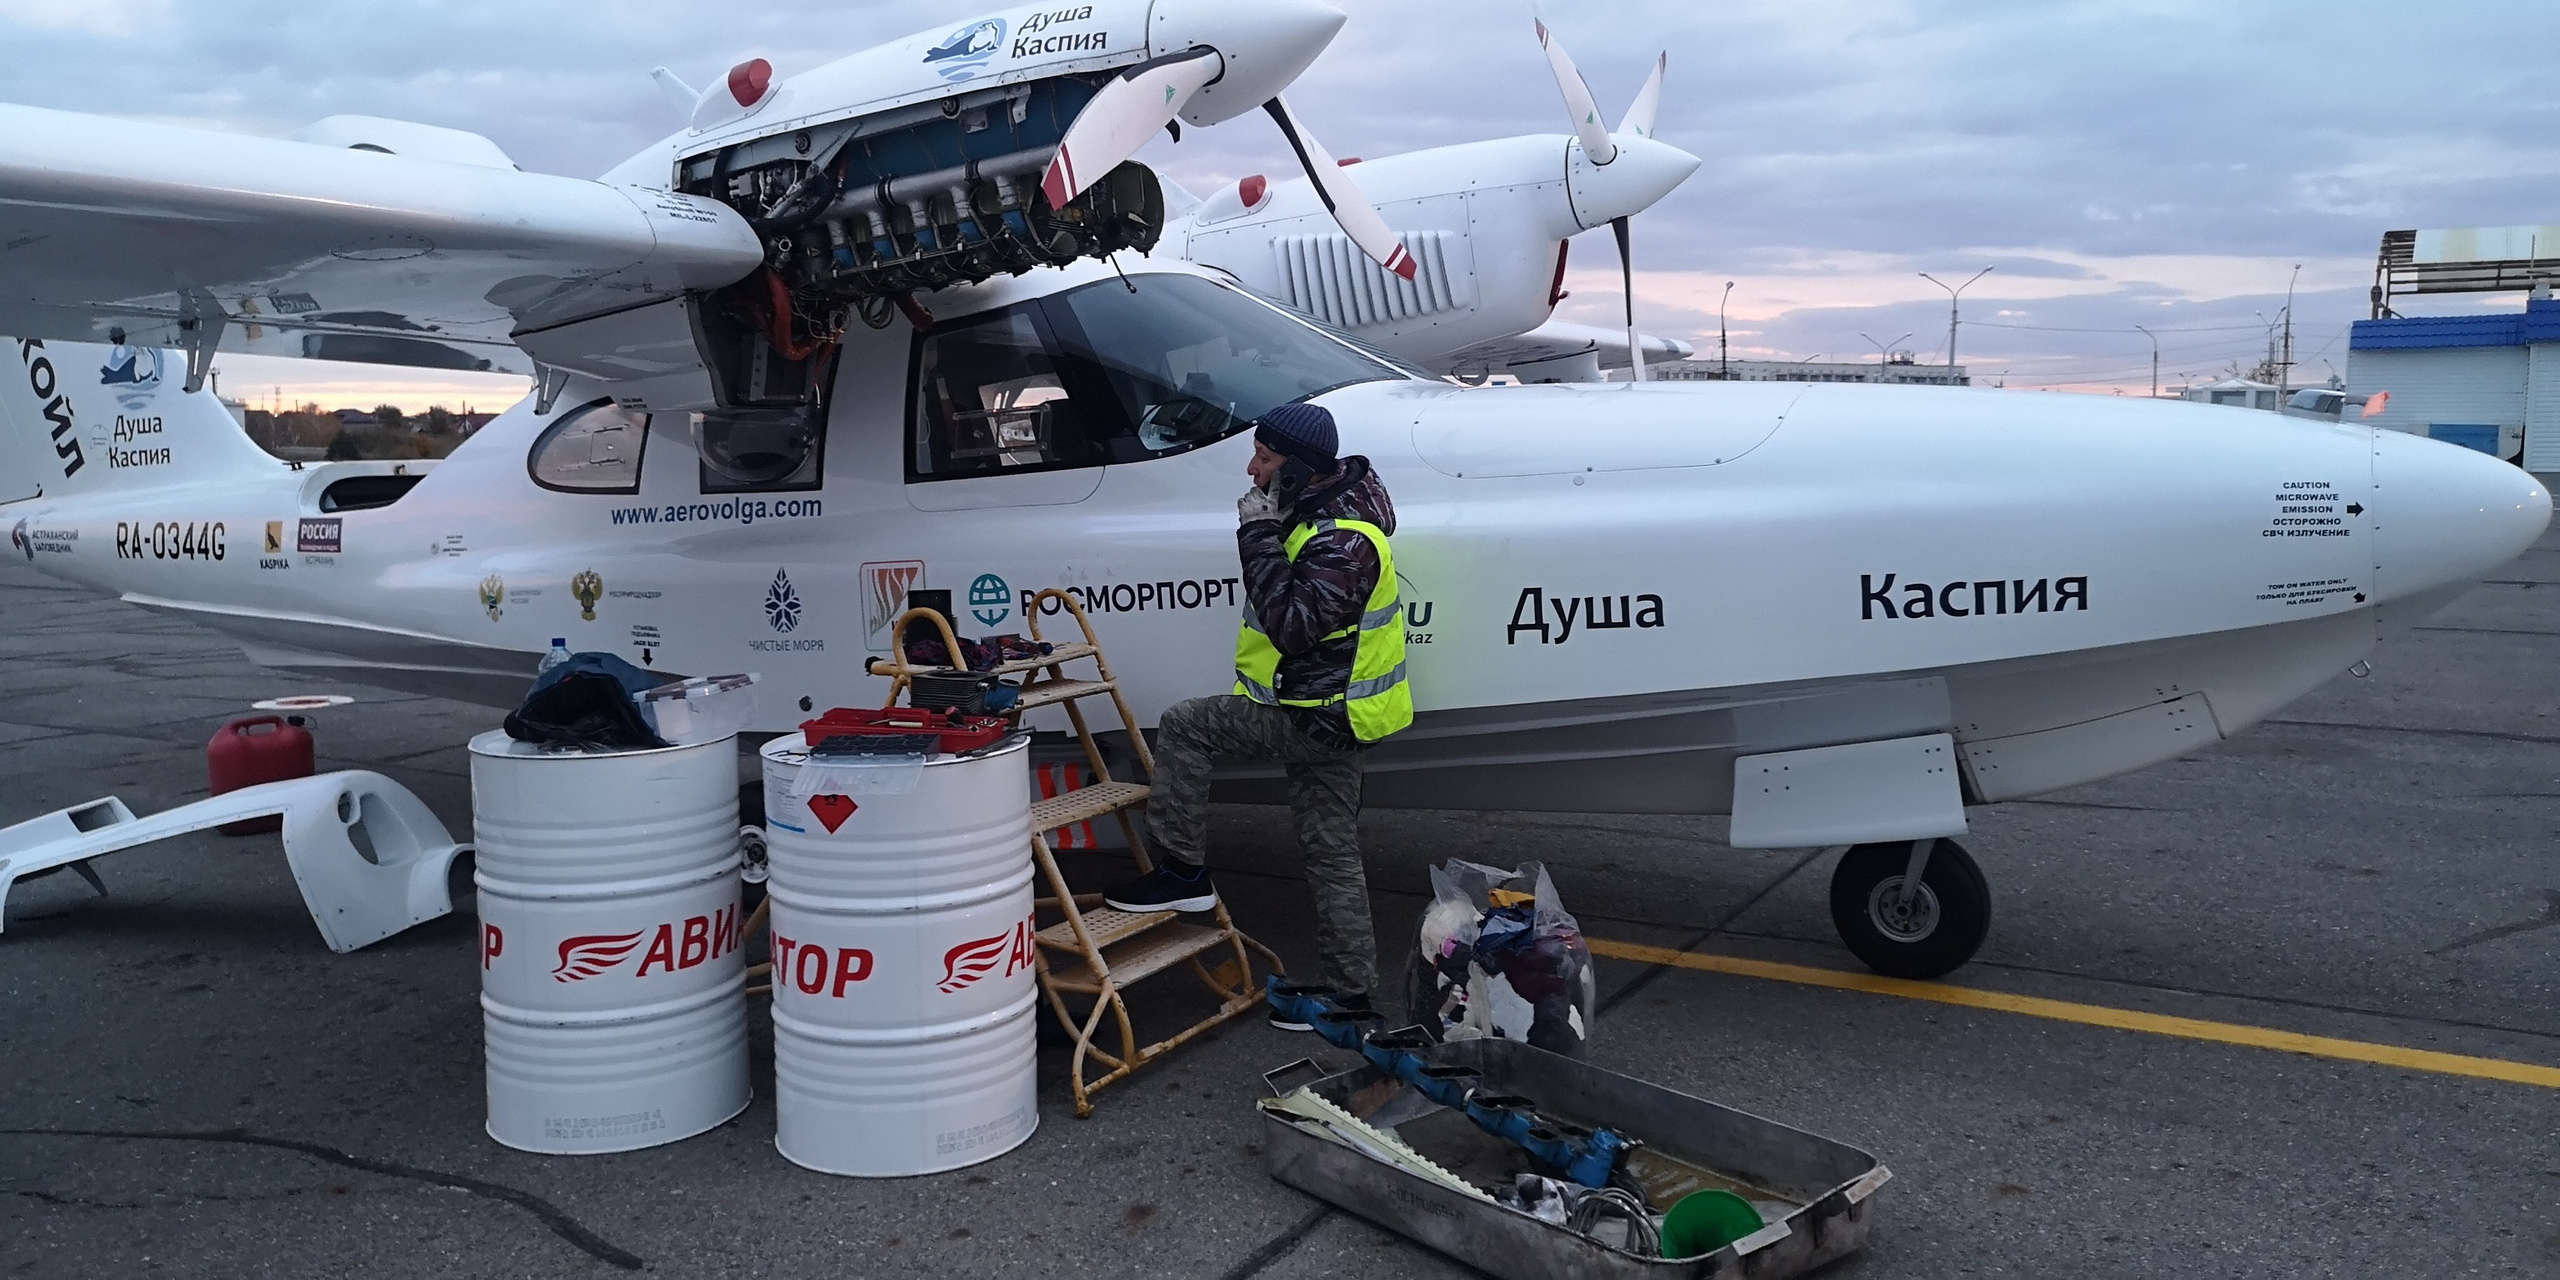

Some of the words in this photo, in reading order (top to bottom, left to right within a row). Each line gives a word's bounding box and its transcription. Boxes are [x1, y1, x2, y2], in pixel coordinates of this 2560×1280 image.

[1018, 6, 1093, 35] Душа
[1011, 32, 1107, 58] Каспия
[114, 415, 163, 443] Душа
[109, 447, 171, 469] Каспия
[2275, 493, 2339, 501] MICROWAVE
[611, 497, 822, 524] www.aerovolga.com
[2272, 518, 2341, 526] ОСТОРОЖНО
[300, 523, 339, 540] РОССИЯ
[2262, 529, 2284, 537] СВЧ
[2287, 529, 2350, 537] ИЗЛУЧЕНИЕ
[116, 522, 225, 561] RA-0344G
[260, 558, 290, 570] KASPIKA
[1020, 578, 1239, 617] РОСМОРПОРТ
[2256, 592, 2287, 600] ТОЛЬКО
[2299, 597, 2325, 605] ПЛАВУ
[1507, 587, 1665, 645] Душа
[1860, 573, 2089, 620] Каспия
[749, 641, 791, 651] ЧИСТЫЕ
[793, 640, 824, 651] МОРЯ
[1403, 630, 1433, 645] kaz
